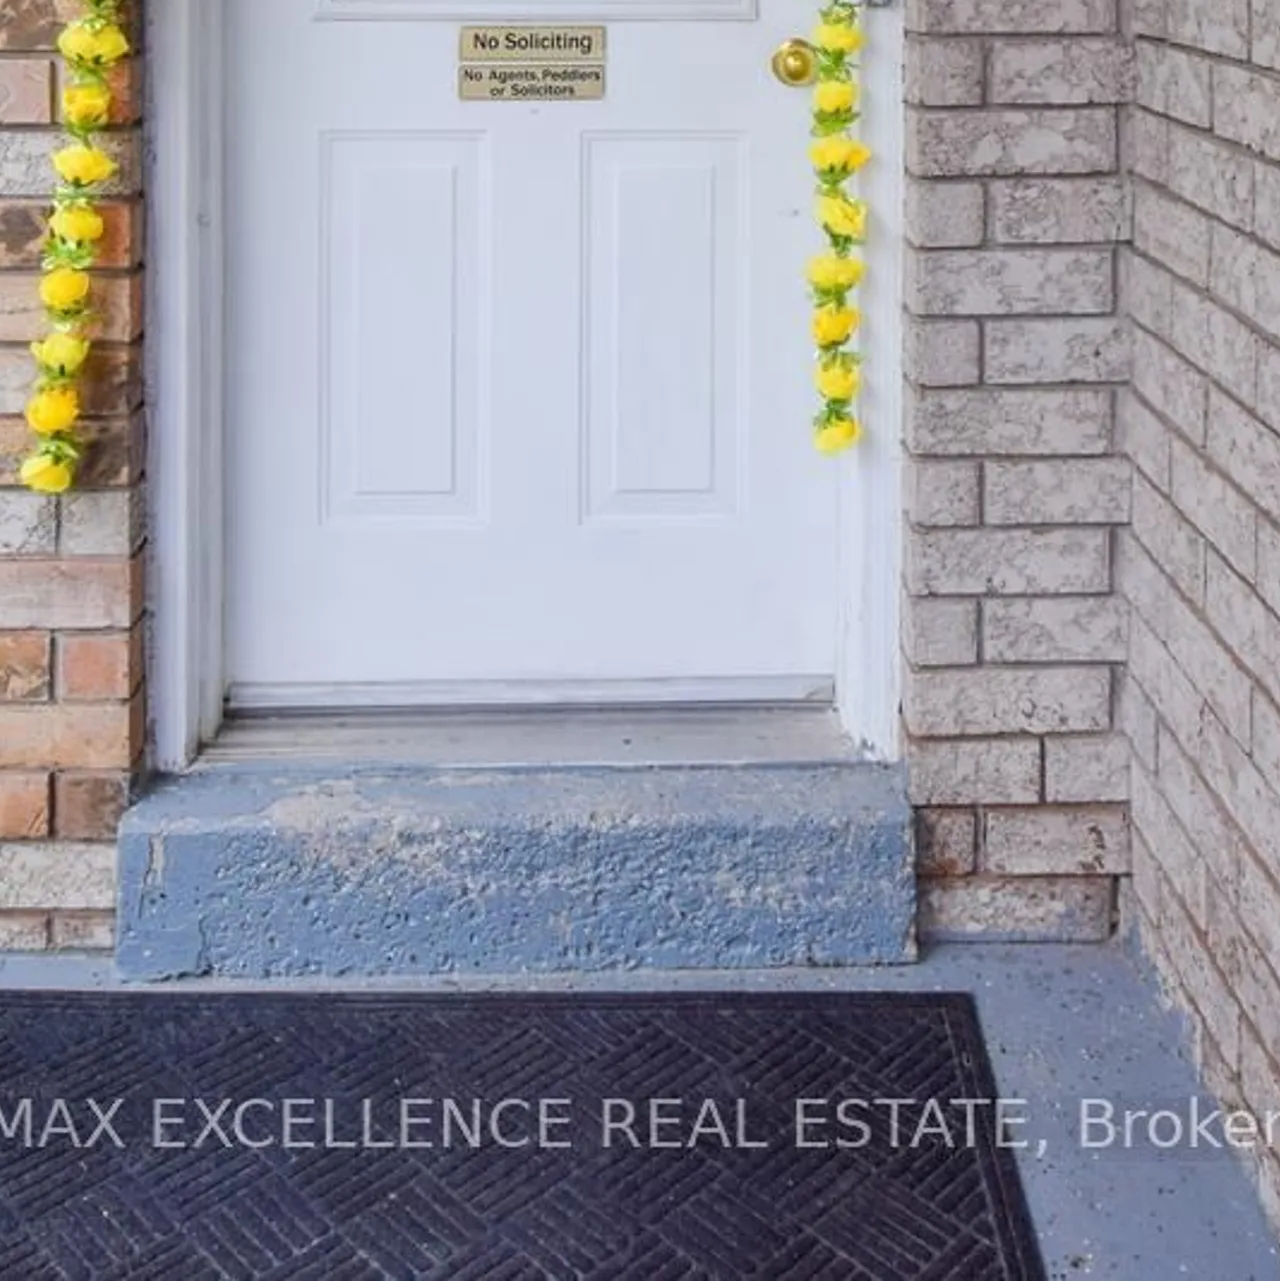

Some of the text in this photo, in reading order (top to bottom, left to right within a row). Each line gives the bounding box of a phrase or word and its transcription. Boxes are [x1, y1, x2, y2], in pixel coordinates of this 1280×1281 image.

[474, 32, 592, 54] No Soliciting
[464, 69, 600, 84] No Agents, Peddlers
[490, 84, 575, 97] or Solicitors
